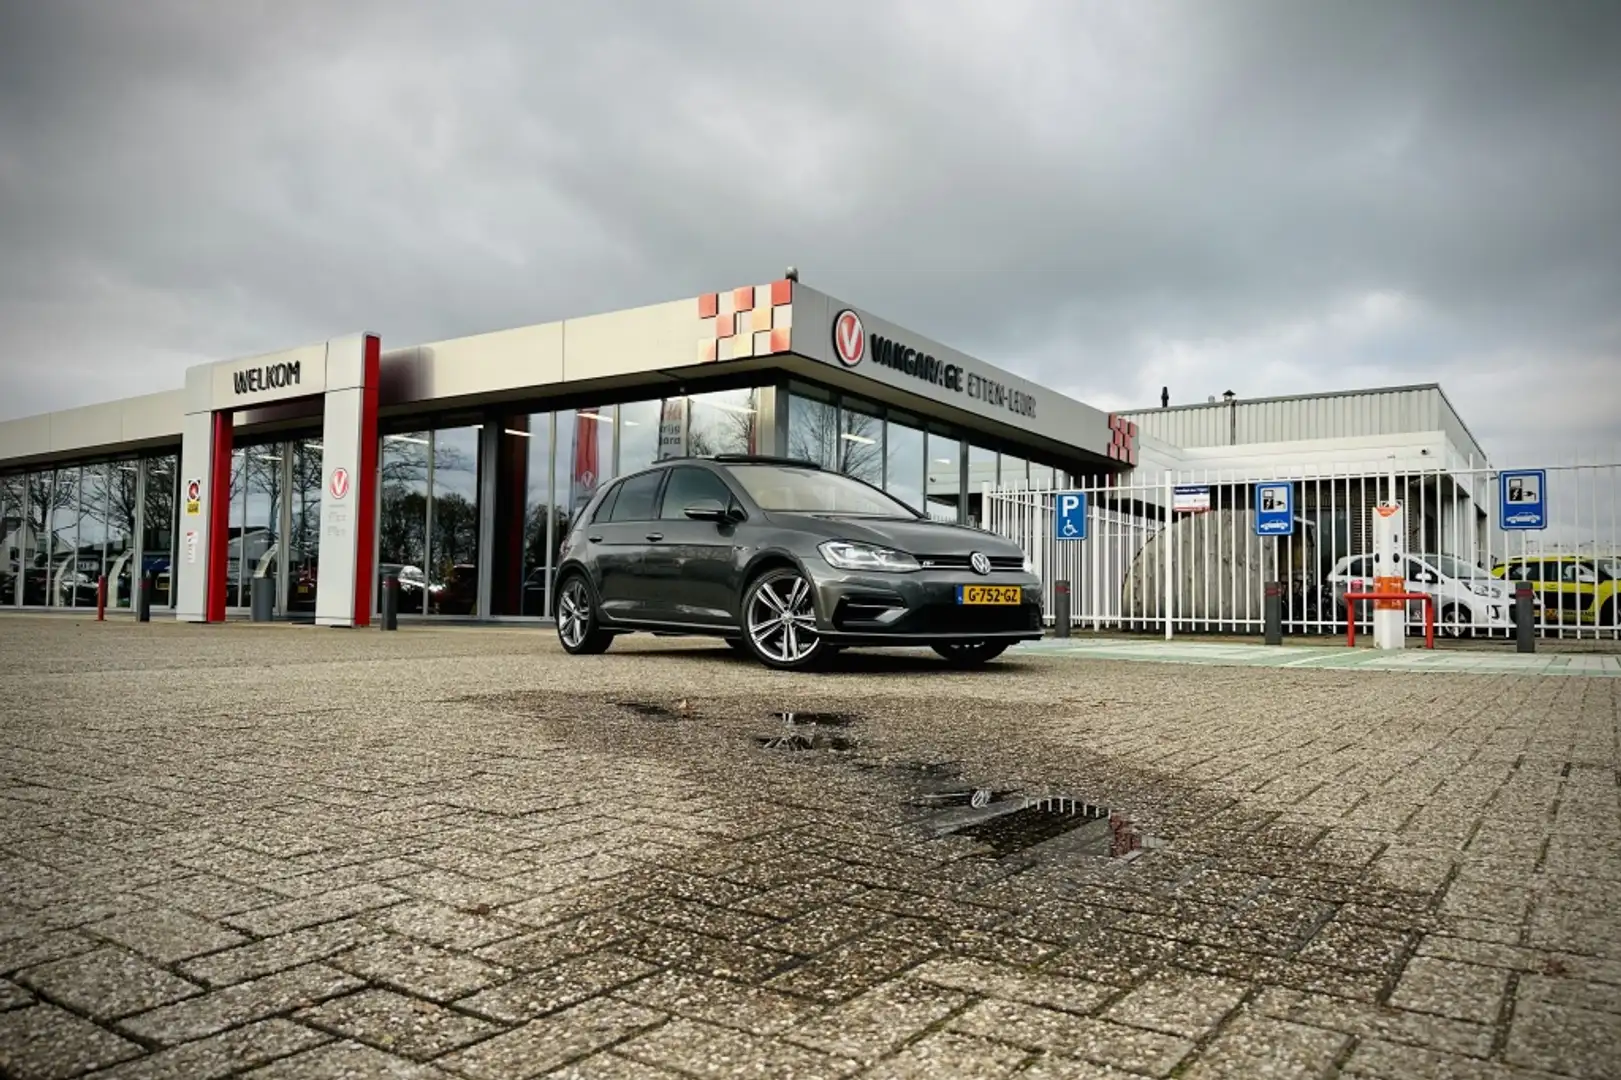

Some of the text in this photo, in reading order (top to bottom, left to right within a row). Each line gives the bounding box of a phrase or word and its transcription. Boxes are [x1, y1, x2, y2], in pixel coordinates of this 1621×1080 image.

[870, 333, 963, 392] VAKGARAGE
[233, 360, 300, 394] WELKOM
[1062, 496, 1079, 517] P
[968, 588, 1018, 602] G-752-GZ
